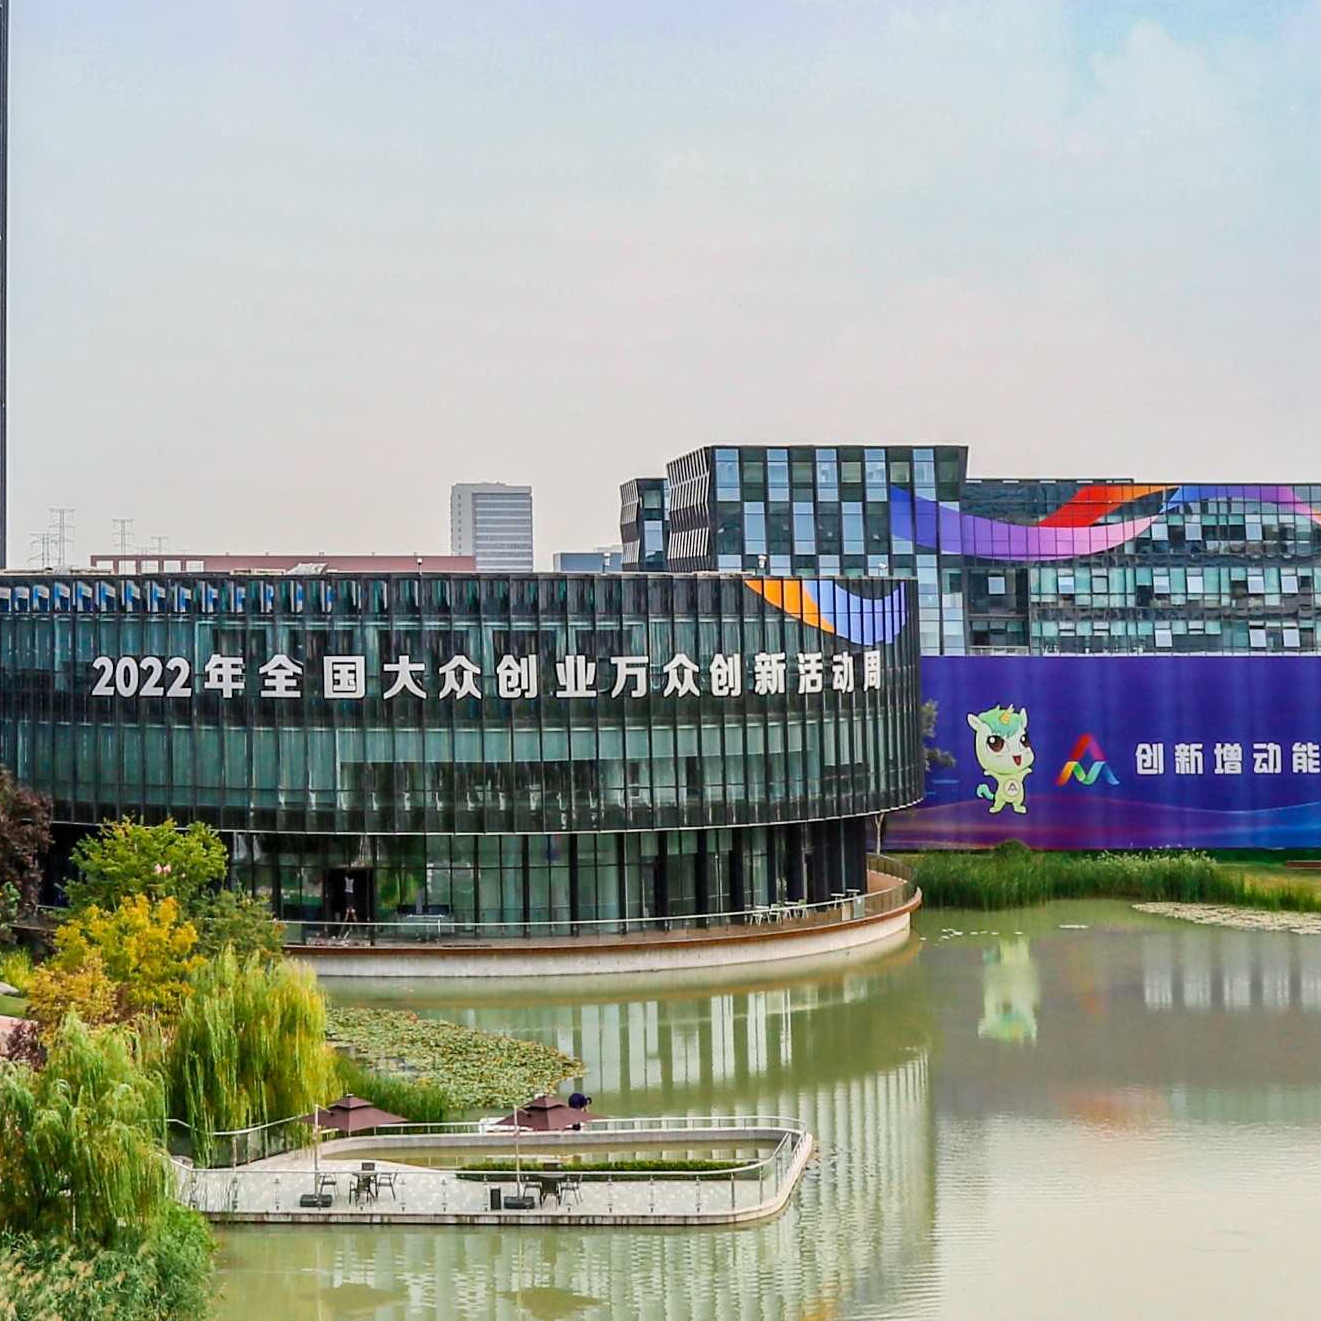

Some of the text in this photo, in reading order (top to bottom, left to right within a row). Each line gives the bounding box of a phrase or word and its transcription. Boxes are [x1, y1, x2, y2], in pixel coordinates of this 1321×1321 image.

[90, 649, 882, 701] 2022年全国大众创业万众创新活动周
[1135, 741, 1321, 776] 创新增动能
